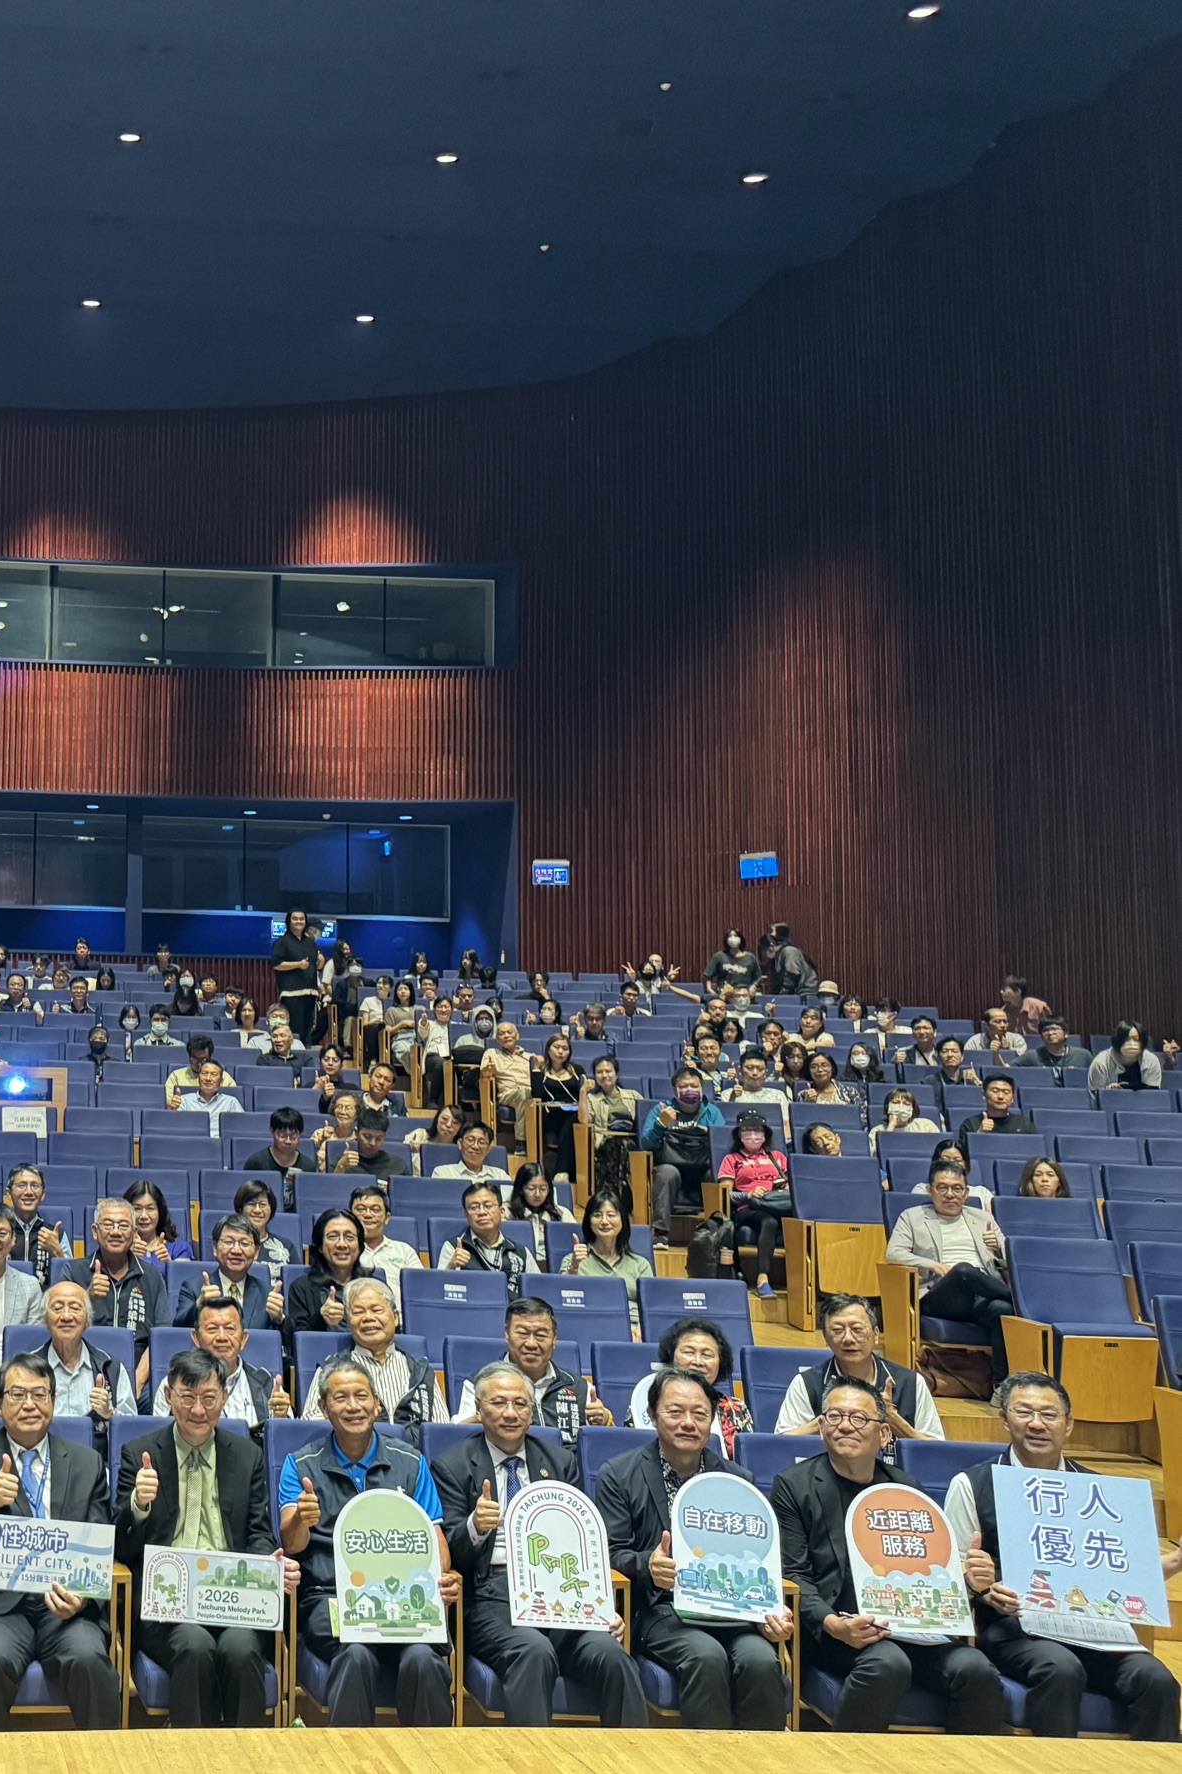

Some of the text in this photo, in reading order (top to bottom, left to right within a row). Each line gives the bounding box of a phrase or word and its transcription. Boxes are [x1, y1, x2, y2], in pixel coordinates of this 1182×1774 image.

[520, 1491, 588, 1517] TAICHUNG 2026
[1024, 1475, 1121, 1521] 行人
[683, 1506, 768, 1539] 自在移動
[866, 1508, 935, 1533] 近距離
[344, 1529, 429, 1554] 安心生活
[880, 1534, 928, 1559] 服務
[1030, 1524, 1127, 1570] 優先
[45, 1557, 71, 1570] CITY
[204, 1588, 239, 1604] 2026
[1124, 1599, 1143, 1610] STOP
[196, 1611, 239, 1621] People-Oriented
[239, 1614, 256, 1623] Street
[197, 1603, 266, 1615] Taichung Melody Park
